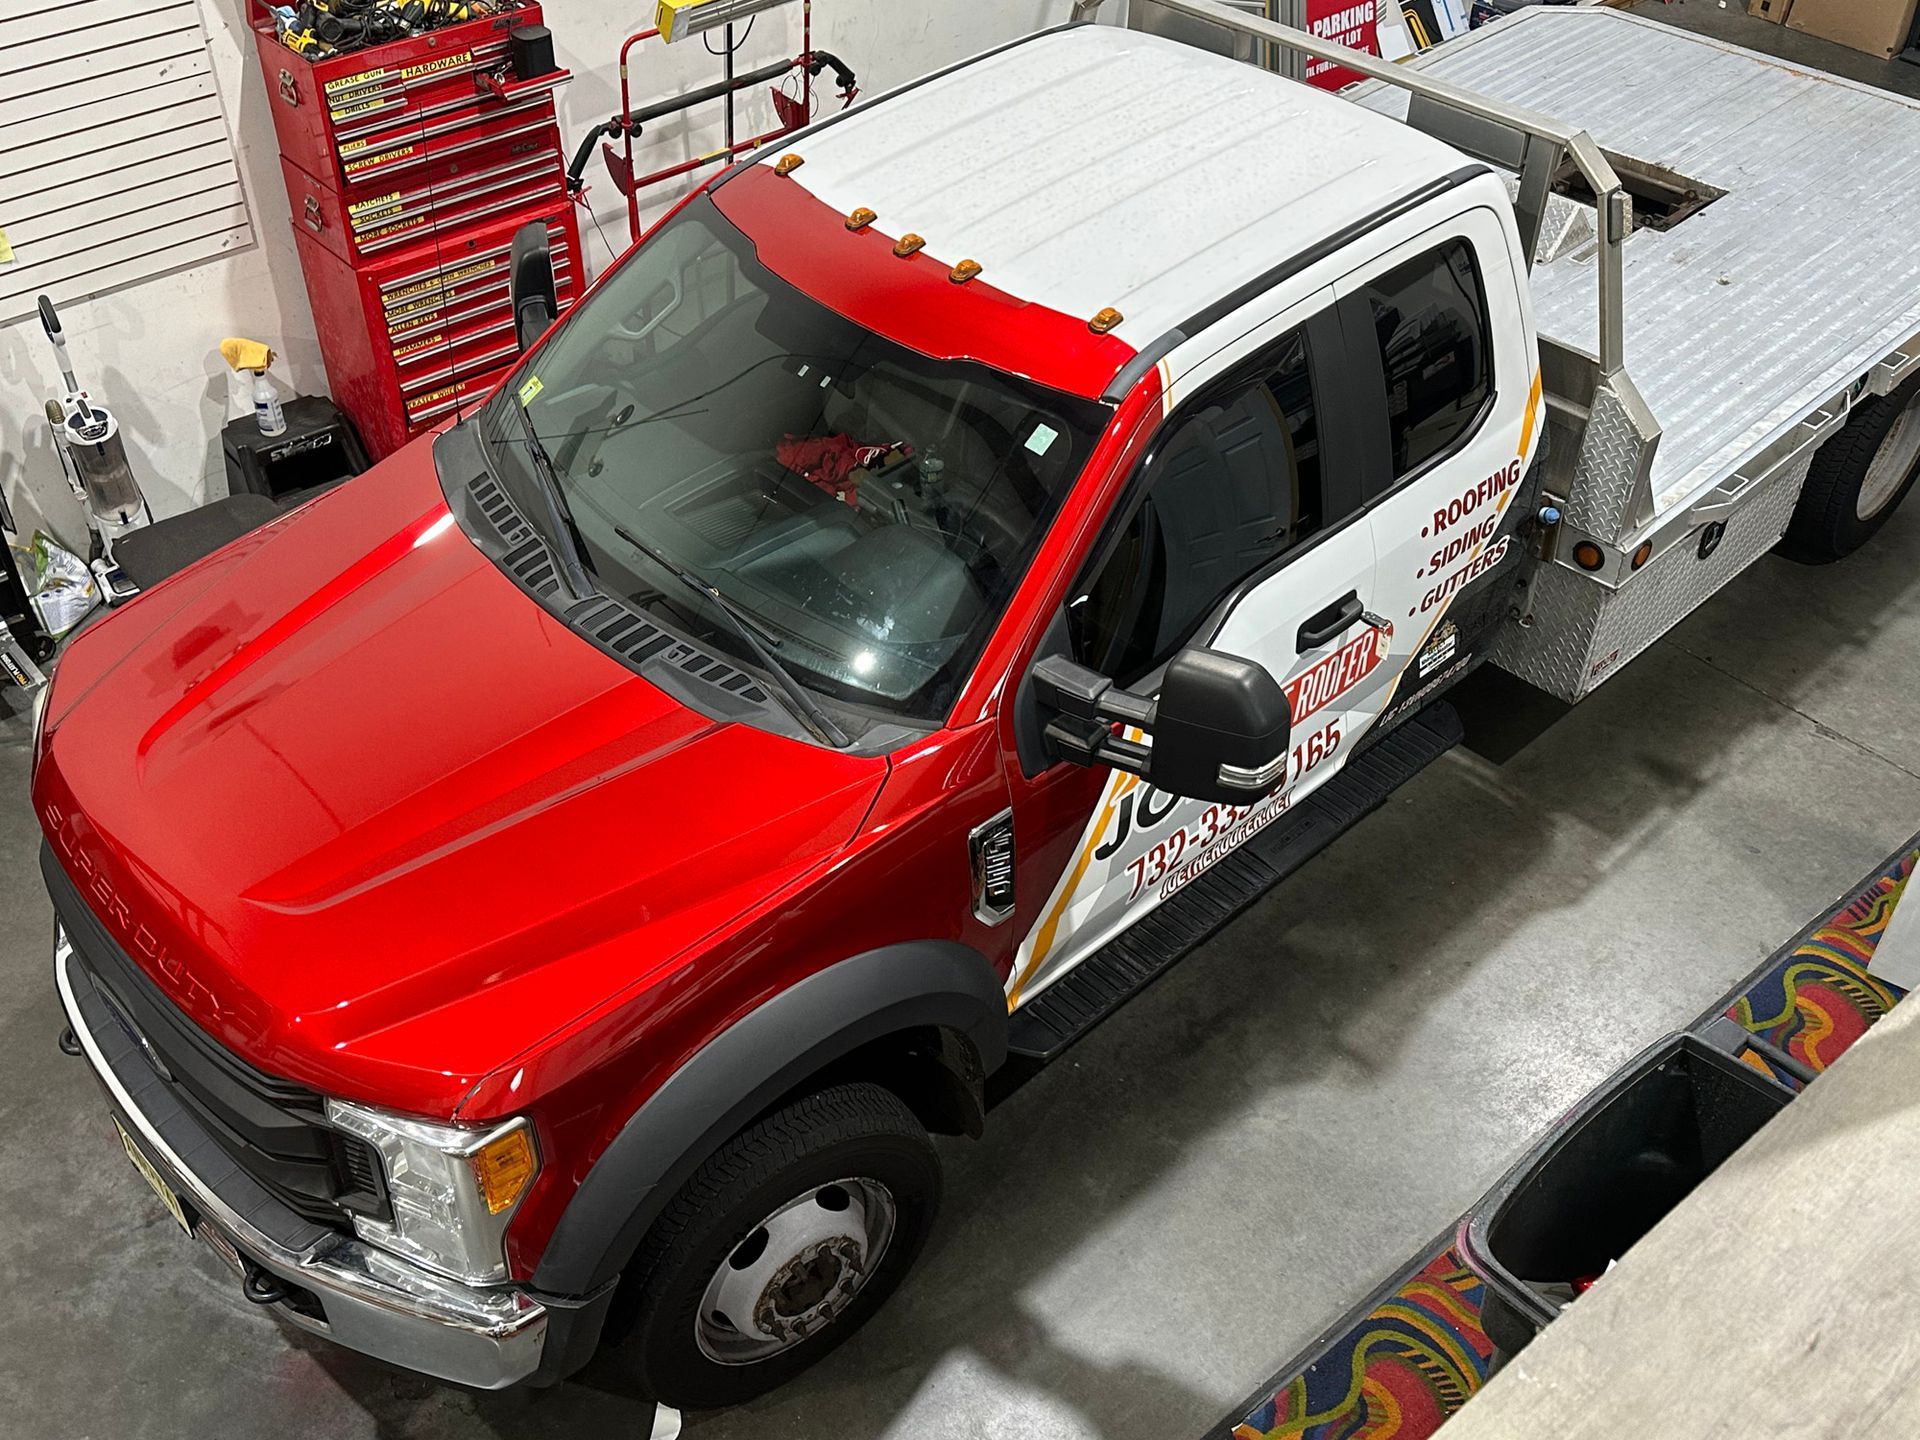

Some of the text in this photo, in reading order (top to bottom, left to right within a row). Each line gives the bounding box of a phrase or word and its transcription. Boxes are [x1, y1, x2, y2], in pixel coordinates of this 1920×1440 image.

[1313, 1, 1374, 38] PARKING
[1345, 28, 1362, 46] LOT
[406, 53, 469, 76] HARDWARE
[328, 70, 382, 89] GREASE GUN
[328, 85, 382, 104] NUT DRIVERS
[345, 103, 370, 114] DRILLS
[343, 141, 365, 151] PLIERS
[348, 148, 411, 170] SCREW DRIVERS
[1434, 459, 1520, 536] ROOFING
[1428, 514, 1496, 576] SIDING
[1420, 539, 1507, 613] GUTTERS
[16, 673, 28, 686] PRO
[1293, 630, 1375, 723] ROOFER
[45, 804, 130, 930] SUPER
[133, 923, 235, 1021] DUTY
